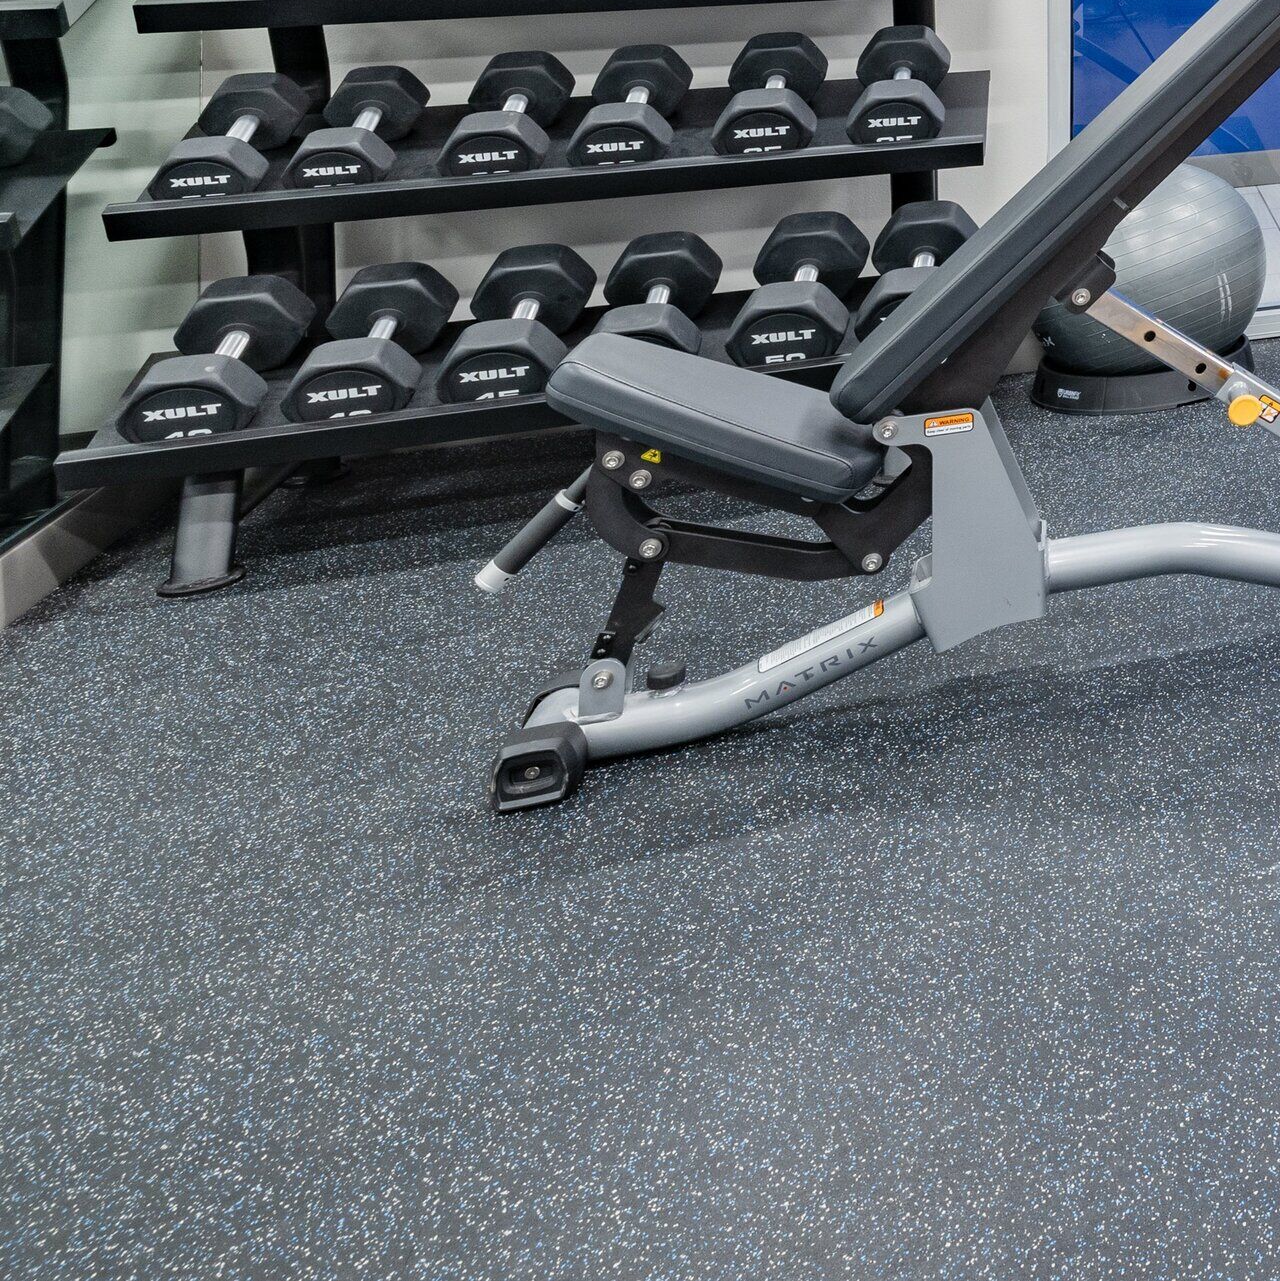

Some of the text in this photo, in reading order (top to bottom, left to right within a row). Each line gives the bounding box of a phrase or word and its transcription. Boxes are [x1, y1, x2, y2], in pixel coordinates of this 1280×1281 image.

[868, 116, 921, 127] XULT
[734, 126, 790, 138] XULT
[587, 141, 644, 153] XULT
[459, 150, 518, 163] XULT
[303, 165, 361, 177] XULT
[170, 175, 230, 187] XULT
[752, 329, 815, 344] XULT
[459, 366, 529, 383] XULT
[307, 385, 381, 403] XULT
[143, 404, 221, 422] XULT
[939, 416, 970, 426] WARNING
[745, 636, 878, 710] MATRIX
